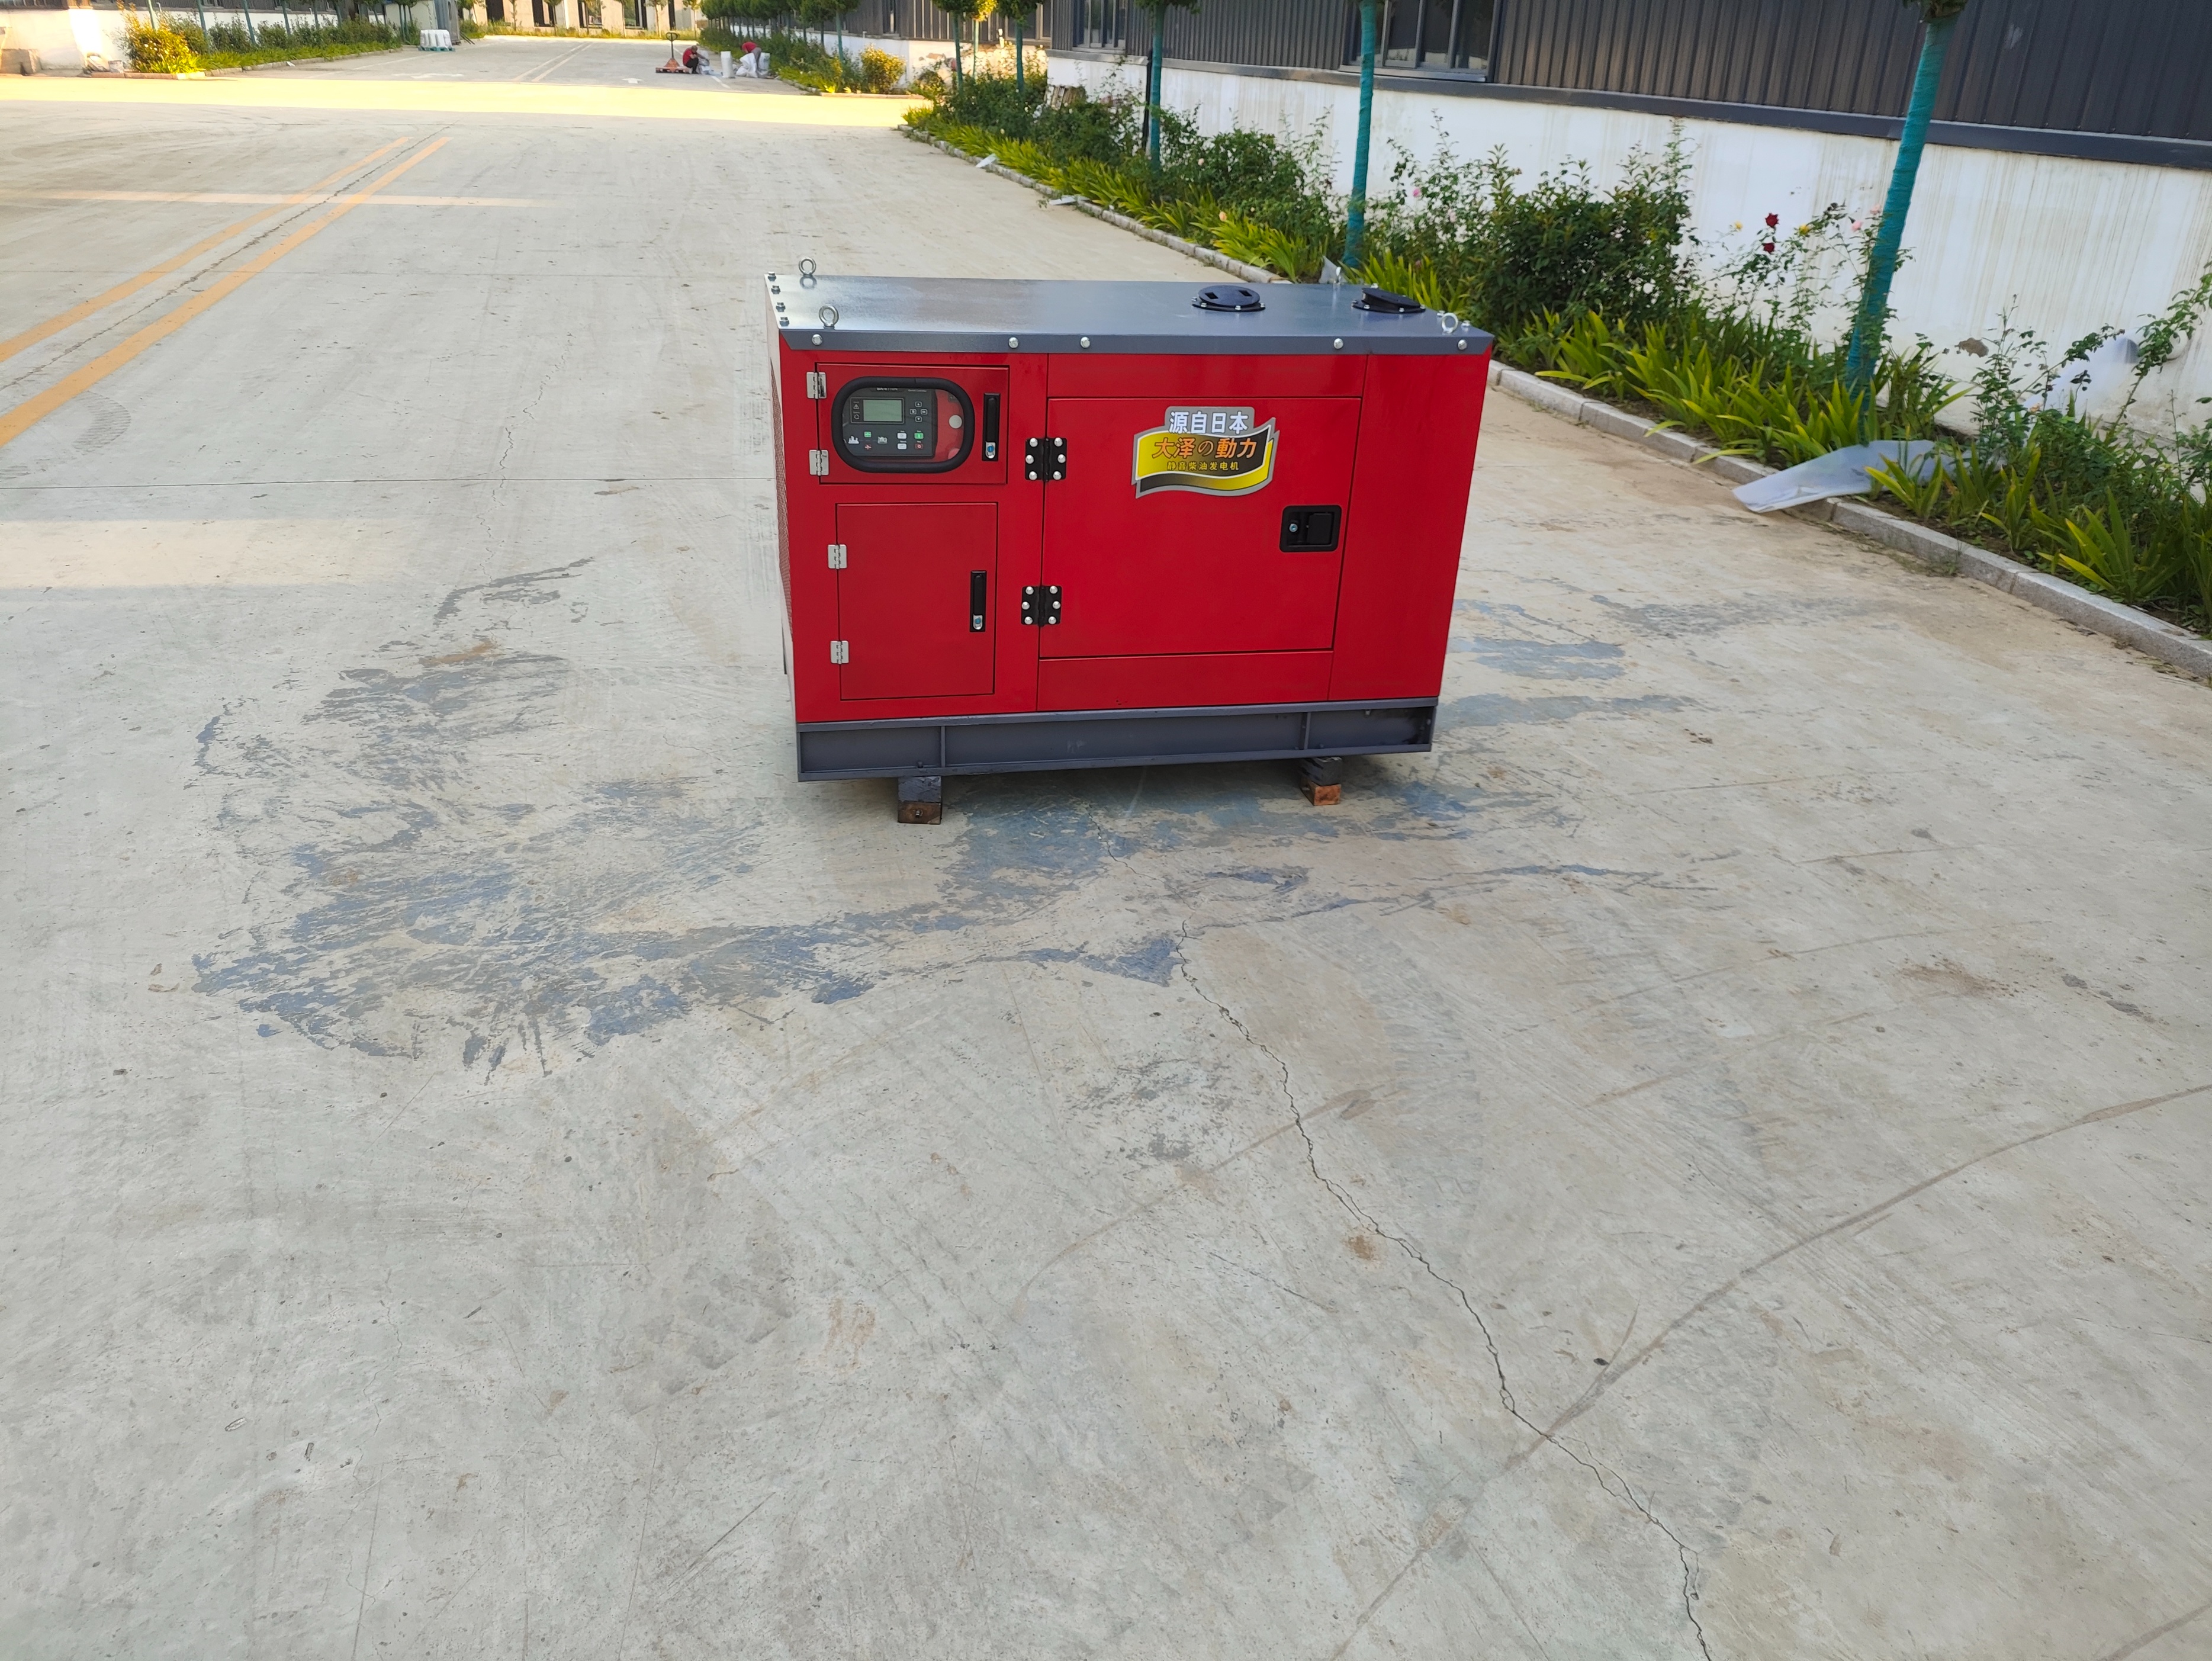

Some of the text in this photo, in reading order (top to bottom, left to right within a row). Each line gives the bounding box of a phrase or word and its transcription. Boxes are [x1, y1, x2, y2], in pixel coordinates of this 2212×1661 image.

[1169, 411, 1249, 434] 源自日本
[1152, 437, 1257, 459] 大泽の動力
[1166, 461, 1239, 471] 静音柴油发电机
